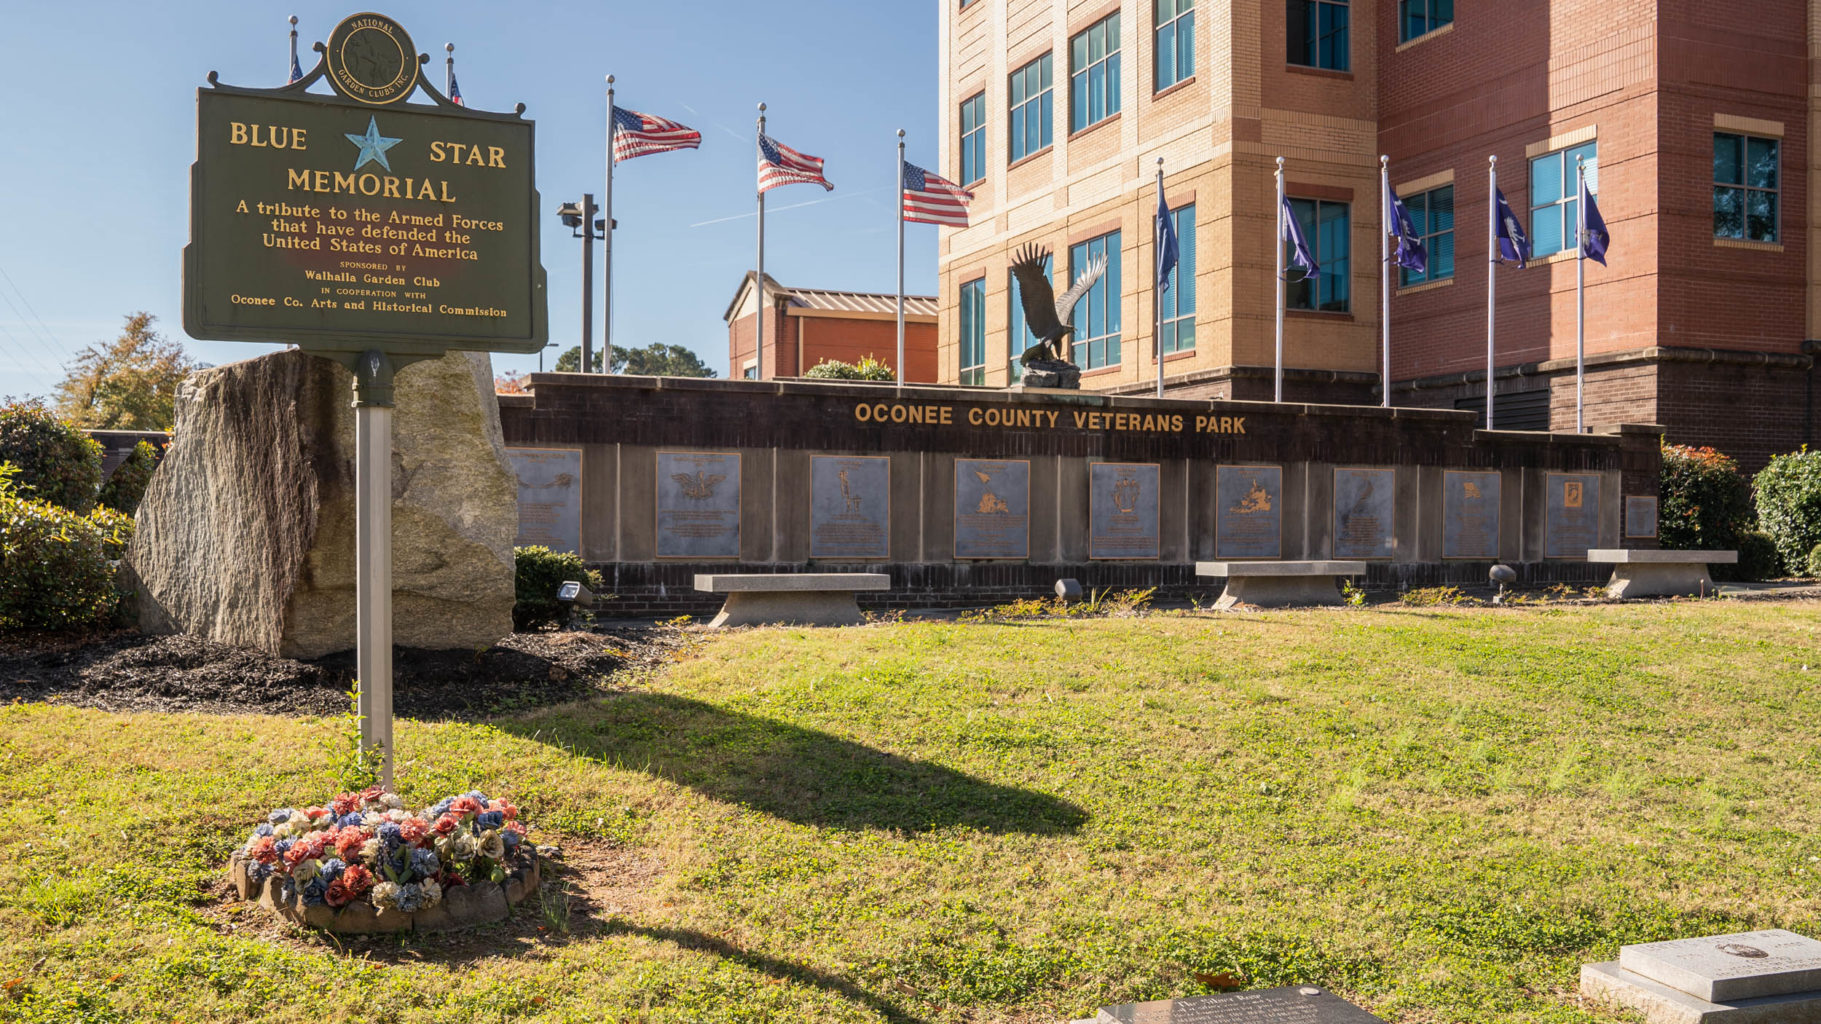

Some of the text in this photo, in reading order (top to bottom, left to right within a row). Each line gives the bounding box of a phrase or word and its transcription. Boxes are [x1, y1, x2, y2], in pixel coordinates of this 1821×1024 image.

[351, 19, 393, 34] NATIONAL
[338, 68, 365, 94] GARDEN
[369, 87, 395, 98] CLUBS
[230, 121, 507, 170] BLUE STAR
[287, 167, 456, 203] MEMORIAL
[236, 199, 504, 232] A tribute to the Armed Forces
[271, 217, 471, 245] that have defended the
[262, 233, 478, 261] United States of America
[305, 270, 440, 288] Walhalla Garden Club
[340, 261, 388, 271] SPONSORED
[231, 294, 507, 318] Oconee Co. Arts and Historical Commission
[337, 288, 396, 298] COOPERATION
[404, 291, 426, 300] WITH
[854, 402, 1247, 435] OCONEE COUNTY VETERANS PARK
